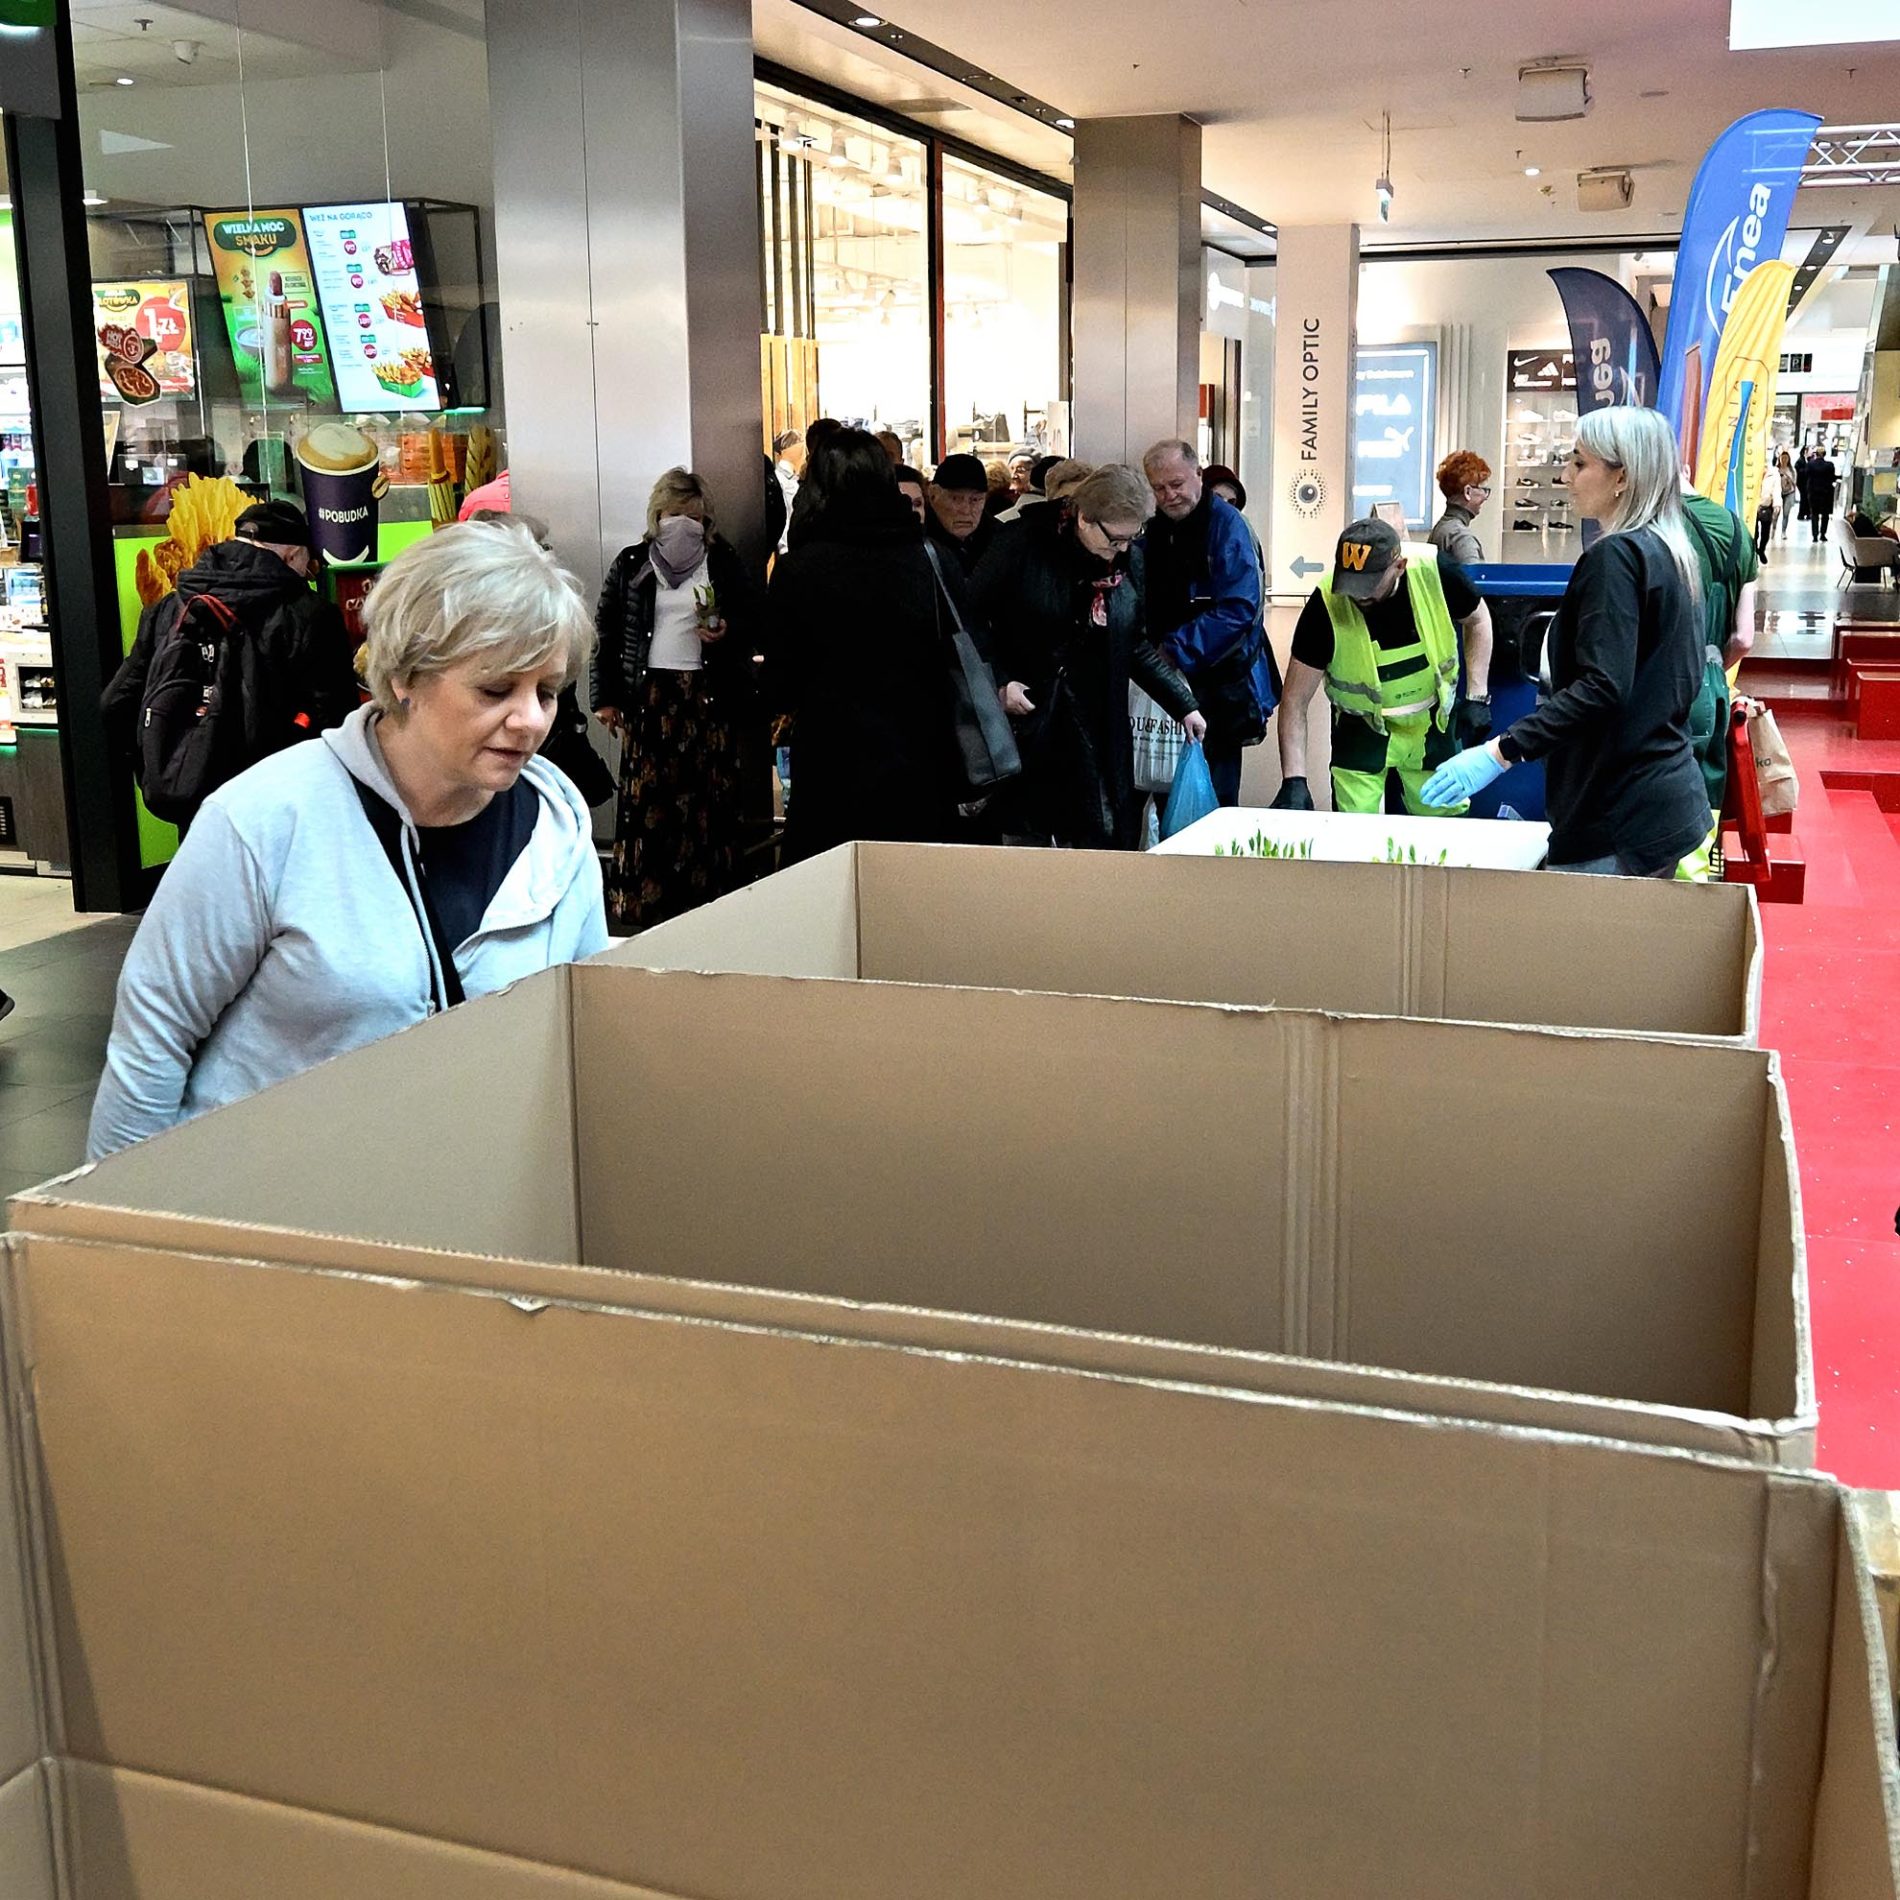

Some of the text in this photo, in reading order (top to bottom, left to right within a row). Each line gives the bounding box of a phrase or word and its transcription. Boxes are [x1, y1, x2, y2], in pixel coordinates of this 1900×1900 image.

[1301, 317, 1320, 461] FAMILY OPTIC
[318, 505, 369, 523] #POBUDKA
[1342, 541, 1372, 571] W
